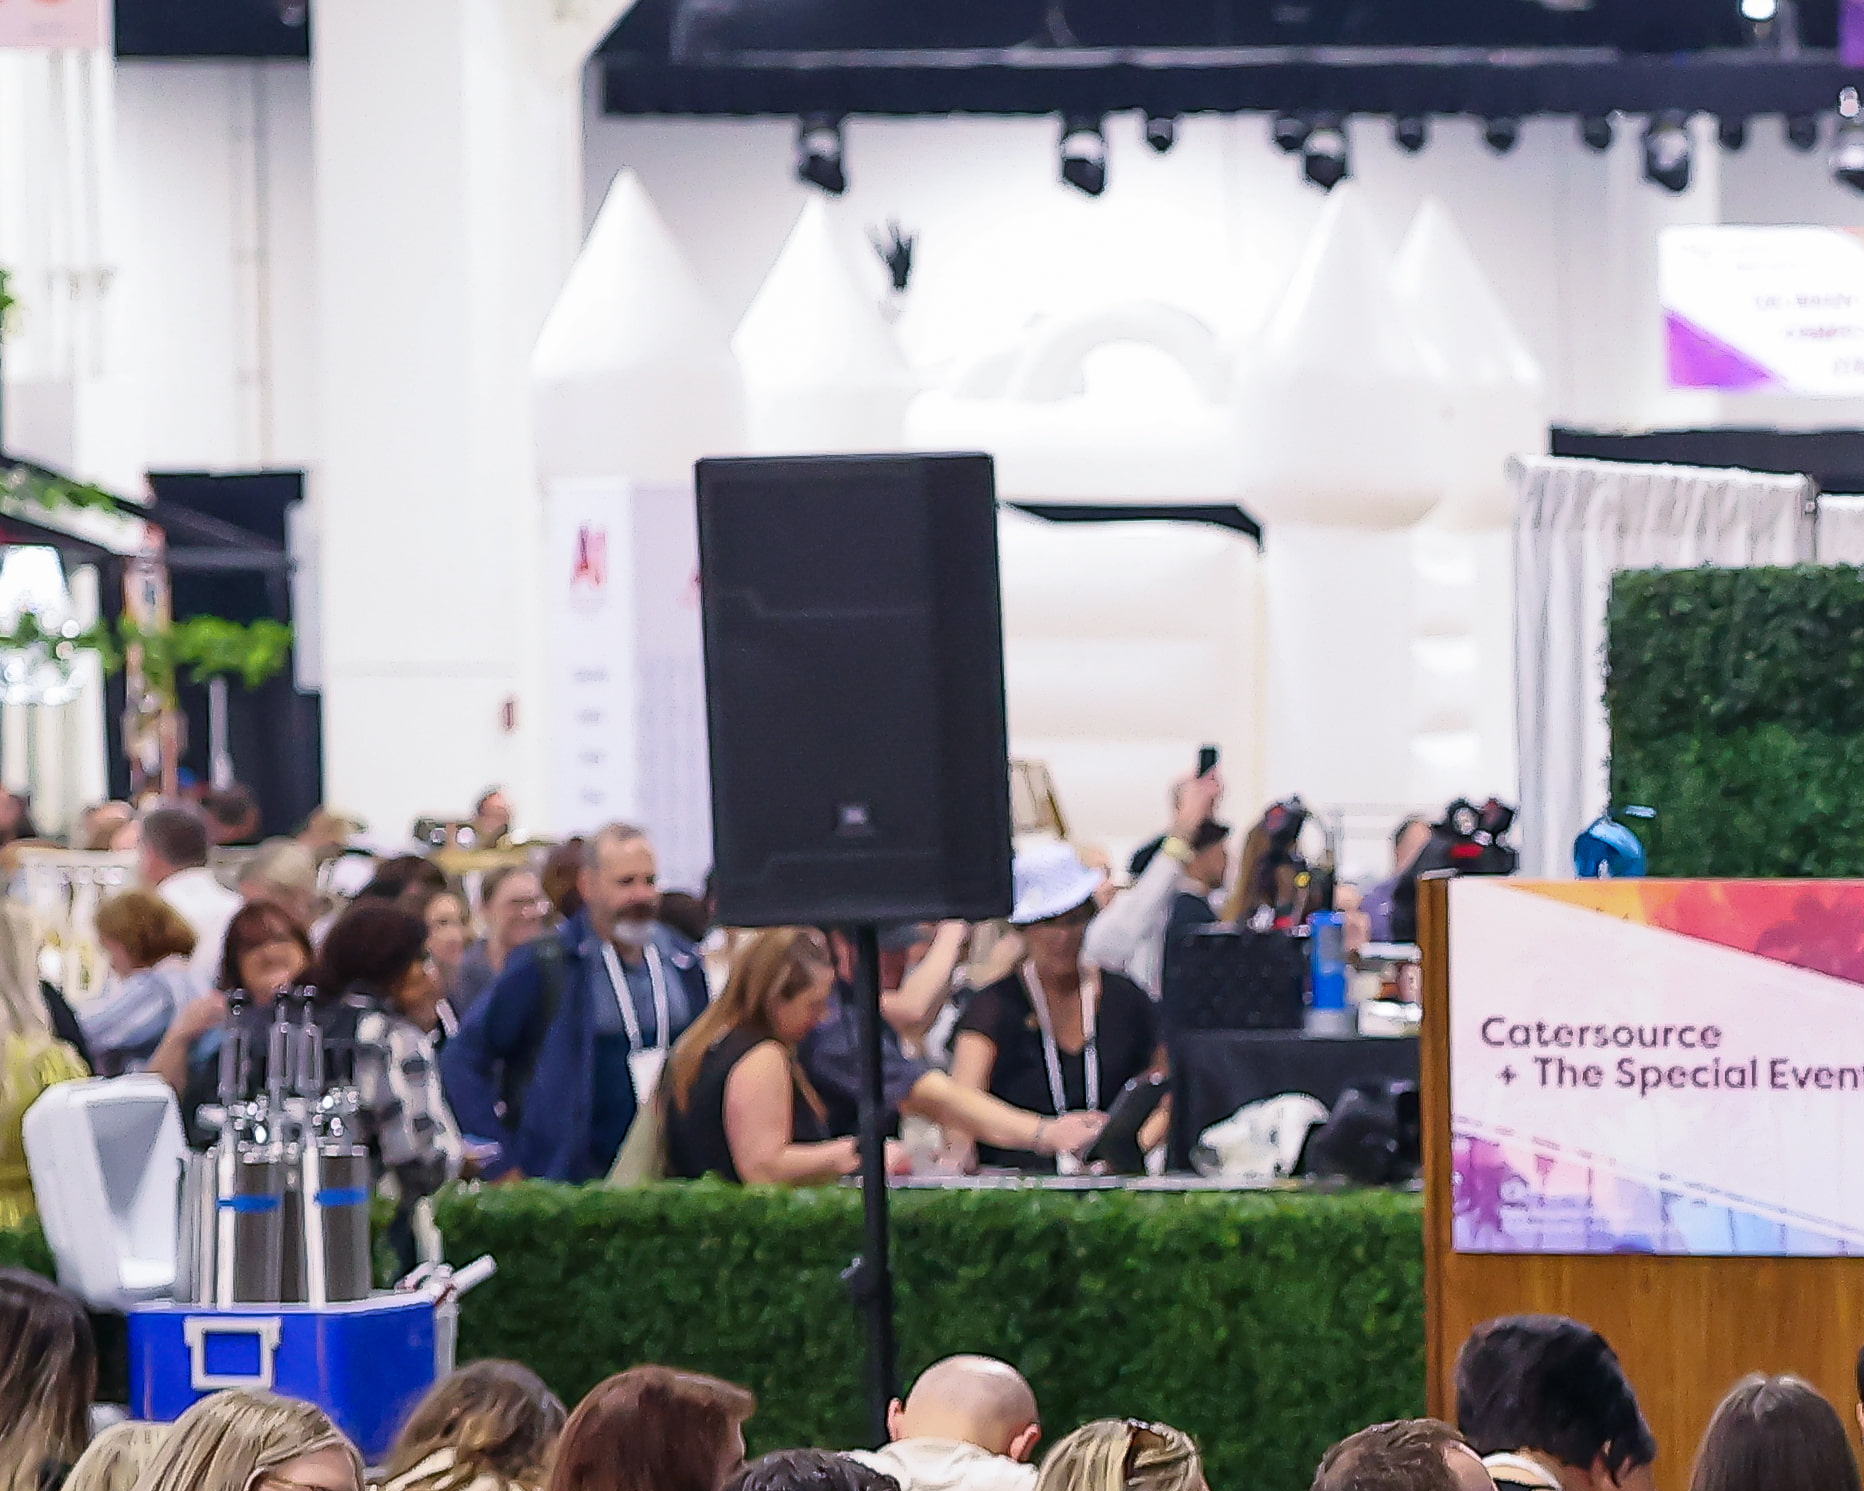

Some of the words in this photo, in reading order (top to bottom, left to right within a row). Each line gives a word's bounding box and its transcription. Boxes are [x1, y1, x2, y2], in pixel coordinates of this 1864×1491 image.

[1481, 1016, 1722, 1049] Catersource
[1533, 1055, 1604, 1089] The
[1616, 1056, 1758, 1099] Special
